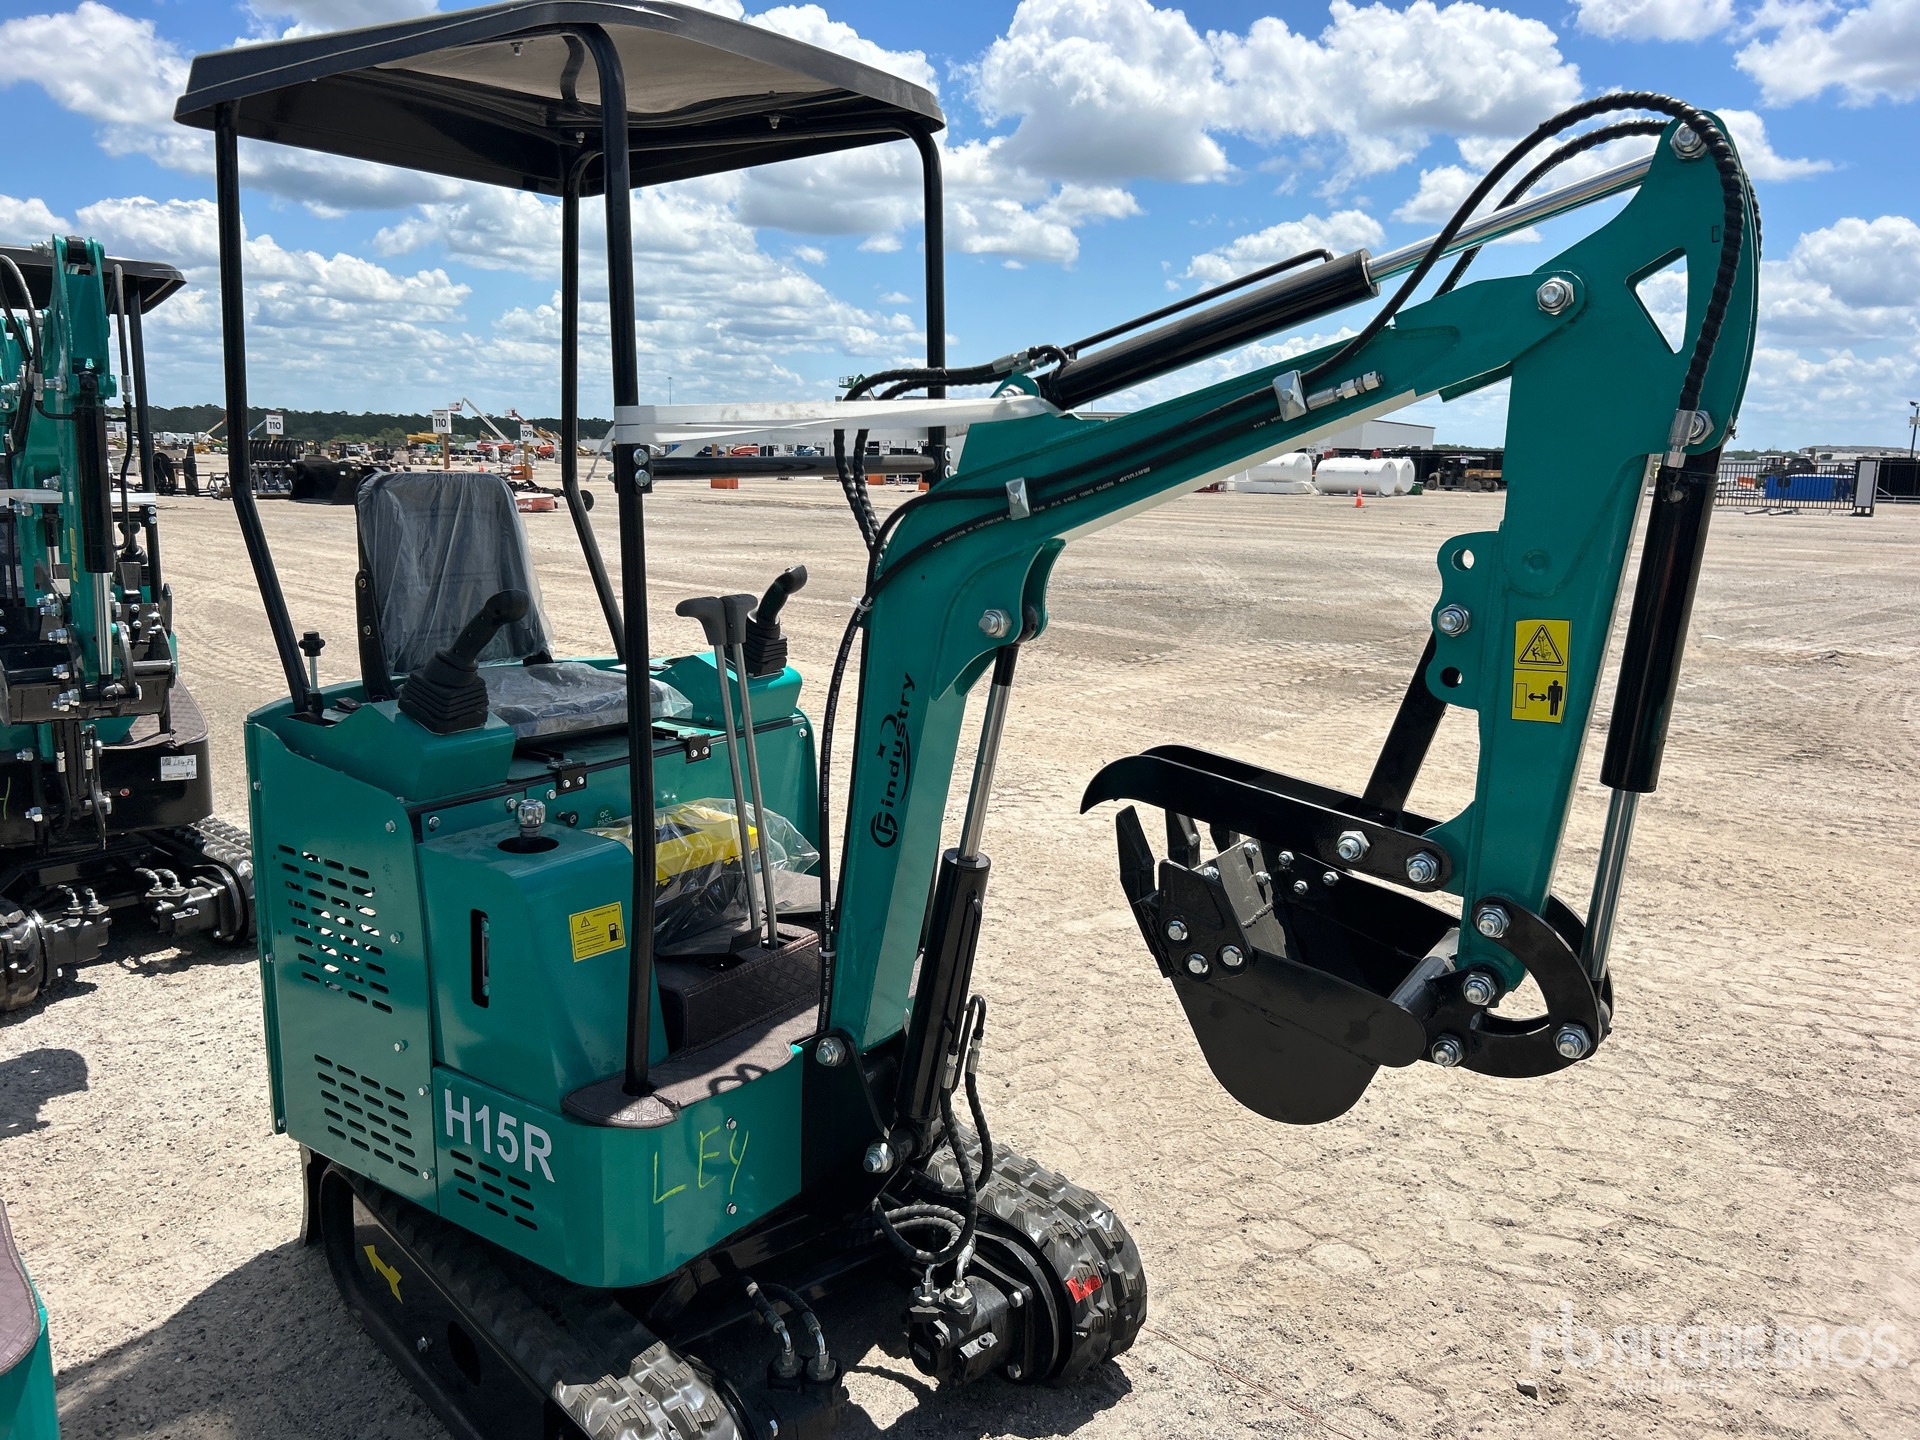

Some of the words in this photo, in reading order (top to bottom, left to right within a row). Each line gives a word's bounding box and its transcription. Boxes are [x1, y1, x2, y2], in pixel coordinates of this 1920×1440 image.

[268, 421, 281, 430] 110
[434, 418, 447, 428] 110
[521, 430, 533, 438] 109
[599, 809, 610, 819] QC
[443, 1088, 556, 1184] H15R
